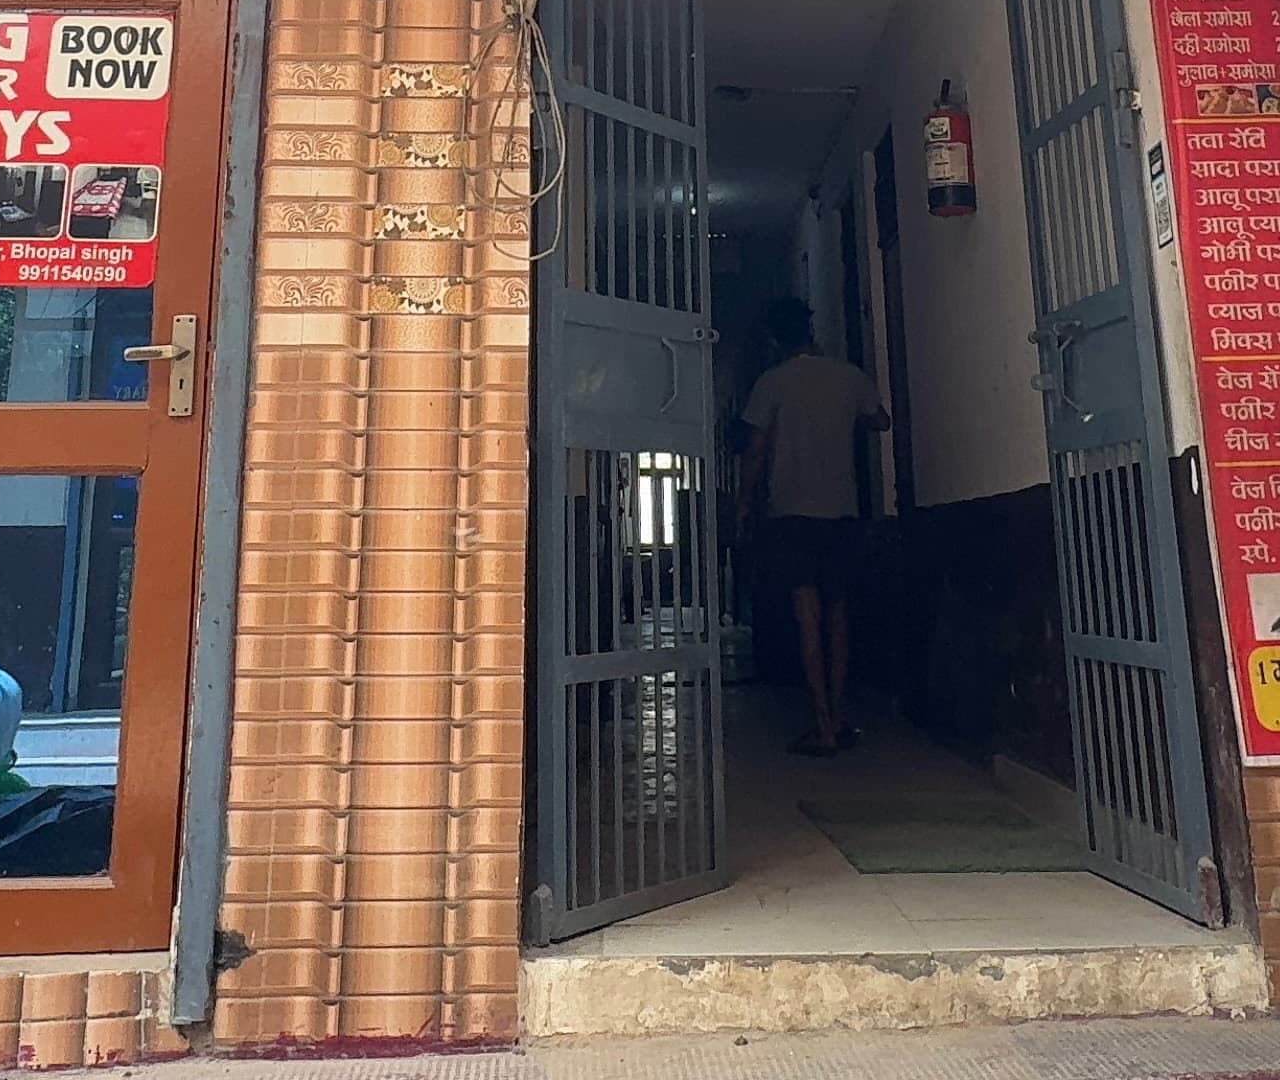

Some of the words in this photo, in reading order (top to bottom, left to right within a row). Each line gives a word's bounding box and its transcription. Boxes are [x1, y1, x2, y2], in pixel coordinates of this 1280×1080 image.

[1204, 6, 1252, 27] समोसा
[60, 24, 164, 56] BOOK
[1173, 33, 1200, 56] दही
[1203, 32, 1251, 53] समोसा
[67, 59, 158, 89] NOW
[1226, 59, 1276, 80] समोसा
[1187, 133, 1224, 151] तवा
[1189, 160, 1240, 178] सादा
[1195, 188, 1251, 211] आलू
[1198, 216, 1255, 240] आलू
[10, 243, 76, 263] Bhopal
[81, 244, 133, 264] singh
[1200, 236, 1251, 263] गोभी
[17, 265, 127, 283] 9911540590
[1204, 269, 1259, 292] पनीर
[1208, 302, 1262, 321] प्याज
[1211, 327, 1272, 351] मिक्स
[1216, 366, 1253, 391] वेज
[1220, 395, 1276, 421] पनीर
[1224, 427, 1270, 451] चीज
[1230, 476, 1265, 501] वेज
